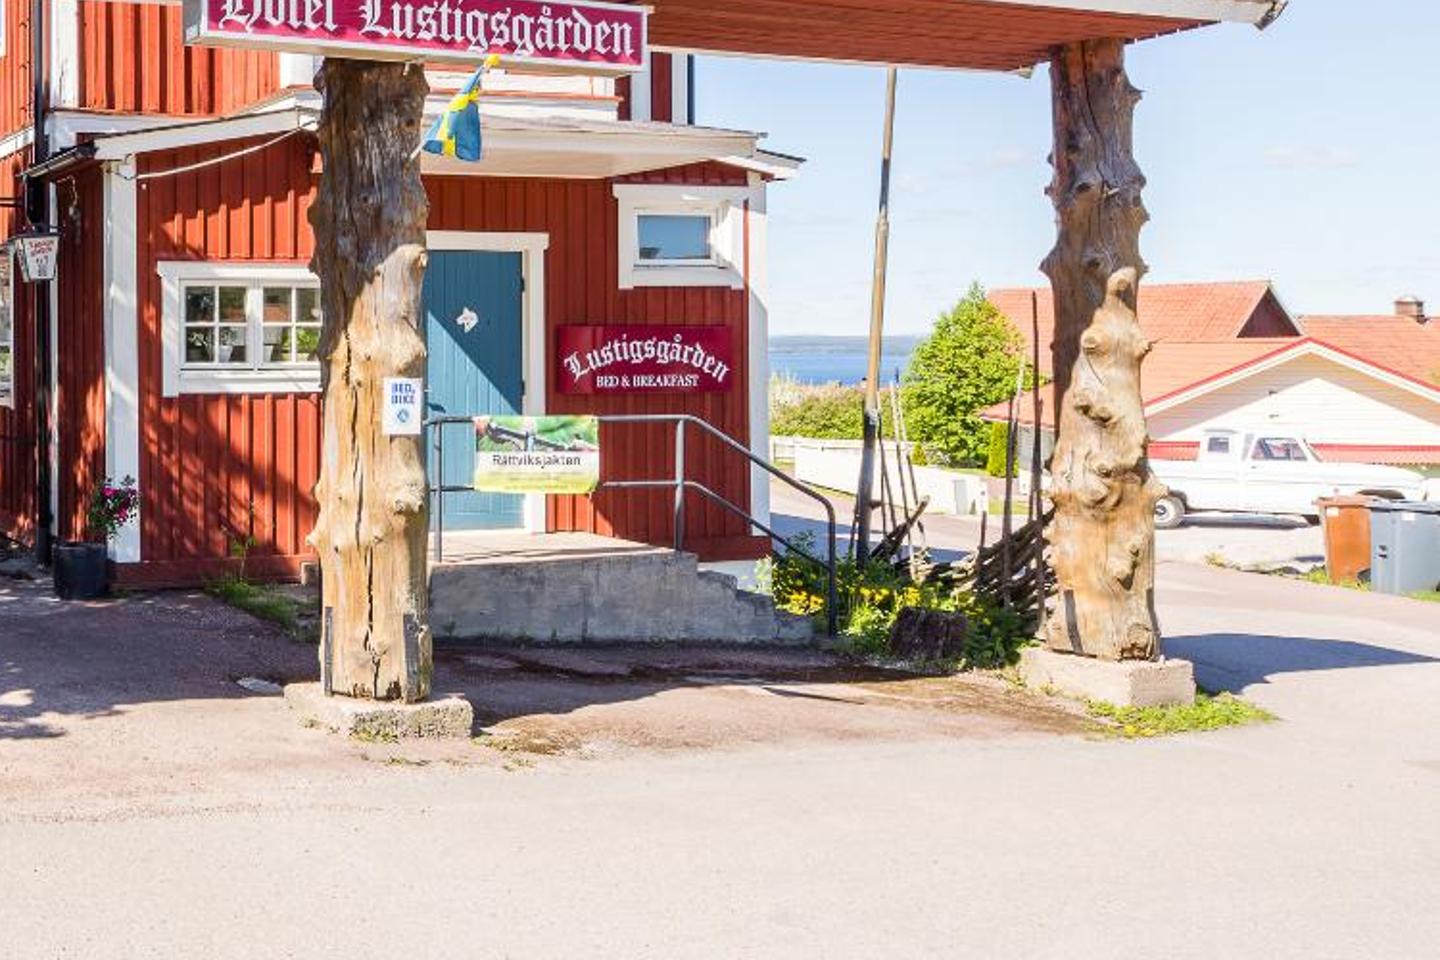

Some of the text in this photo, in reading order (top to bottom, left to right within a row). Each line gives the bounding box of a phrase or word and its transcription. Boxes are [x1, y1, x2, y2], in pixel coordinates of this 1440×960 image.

[563, 333, 731, 383] Lustigsgården
[596, 374, 699, 387] BED & BREAKFAST
